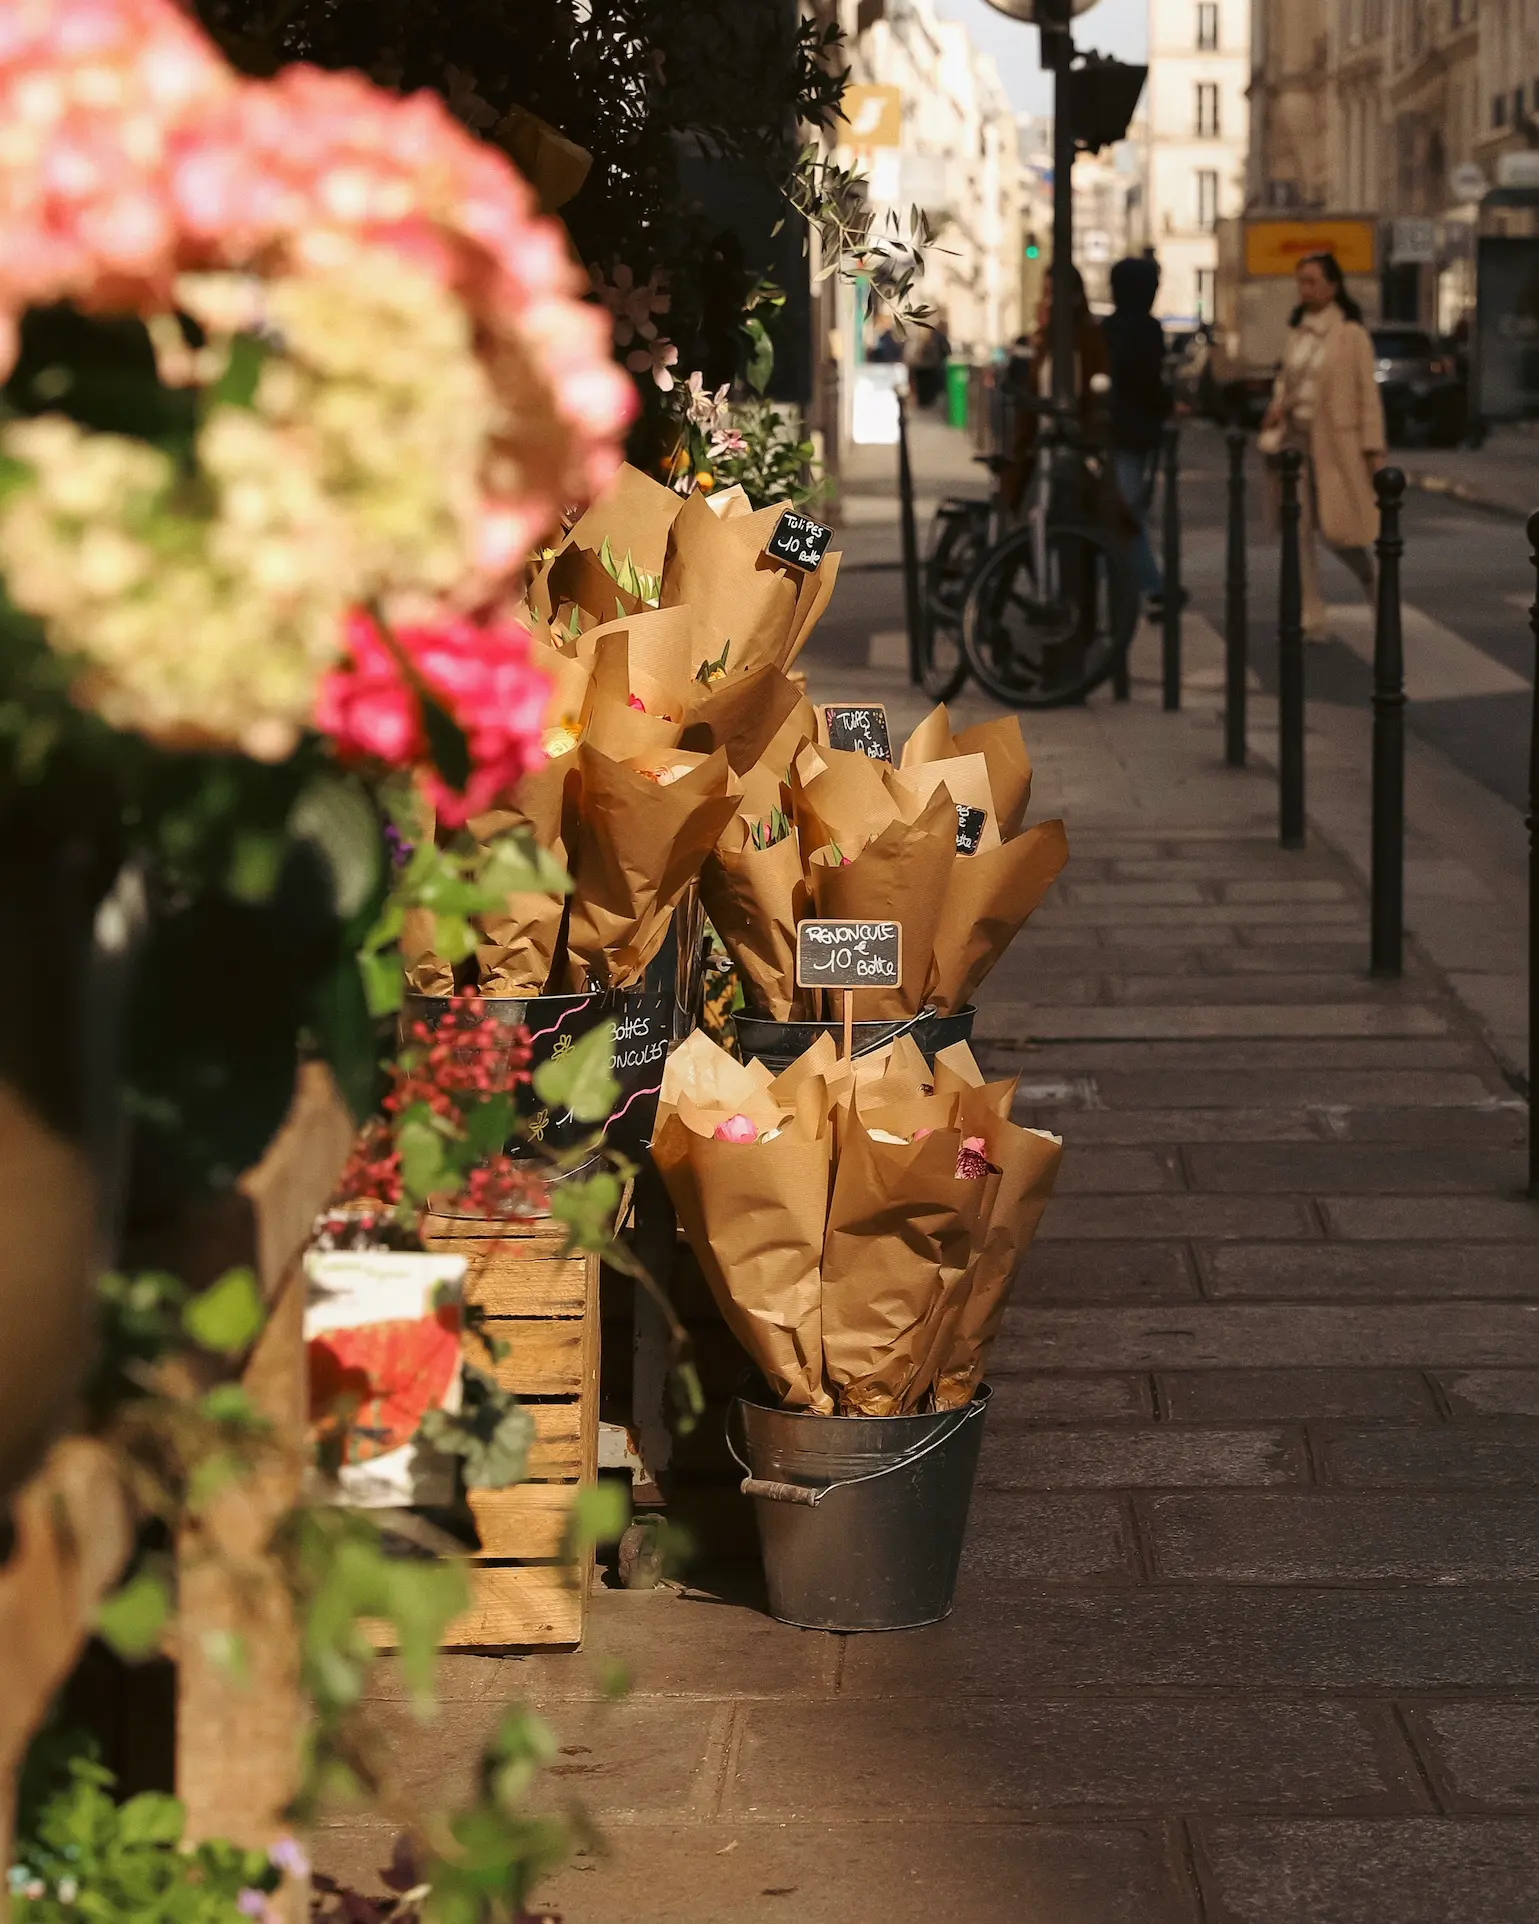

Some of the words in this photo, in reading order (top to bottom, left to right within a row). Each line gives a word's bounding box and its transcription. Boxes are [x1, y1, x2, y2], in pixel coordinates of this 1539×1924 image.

[777, 535, 800, 553] 10
[805, 535, 815, 548] €
[813, 947, 853, 973] 10
[852, 940, 870, 956] €
